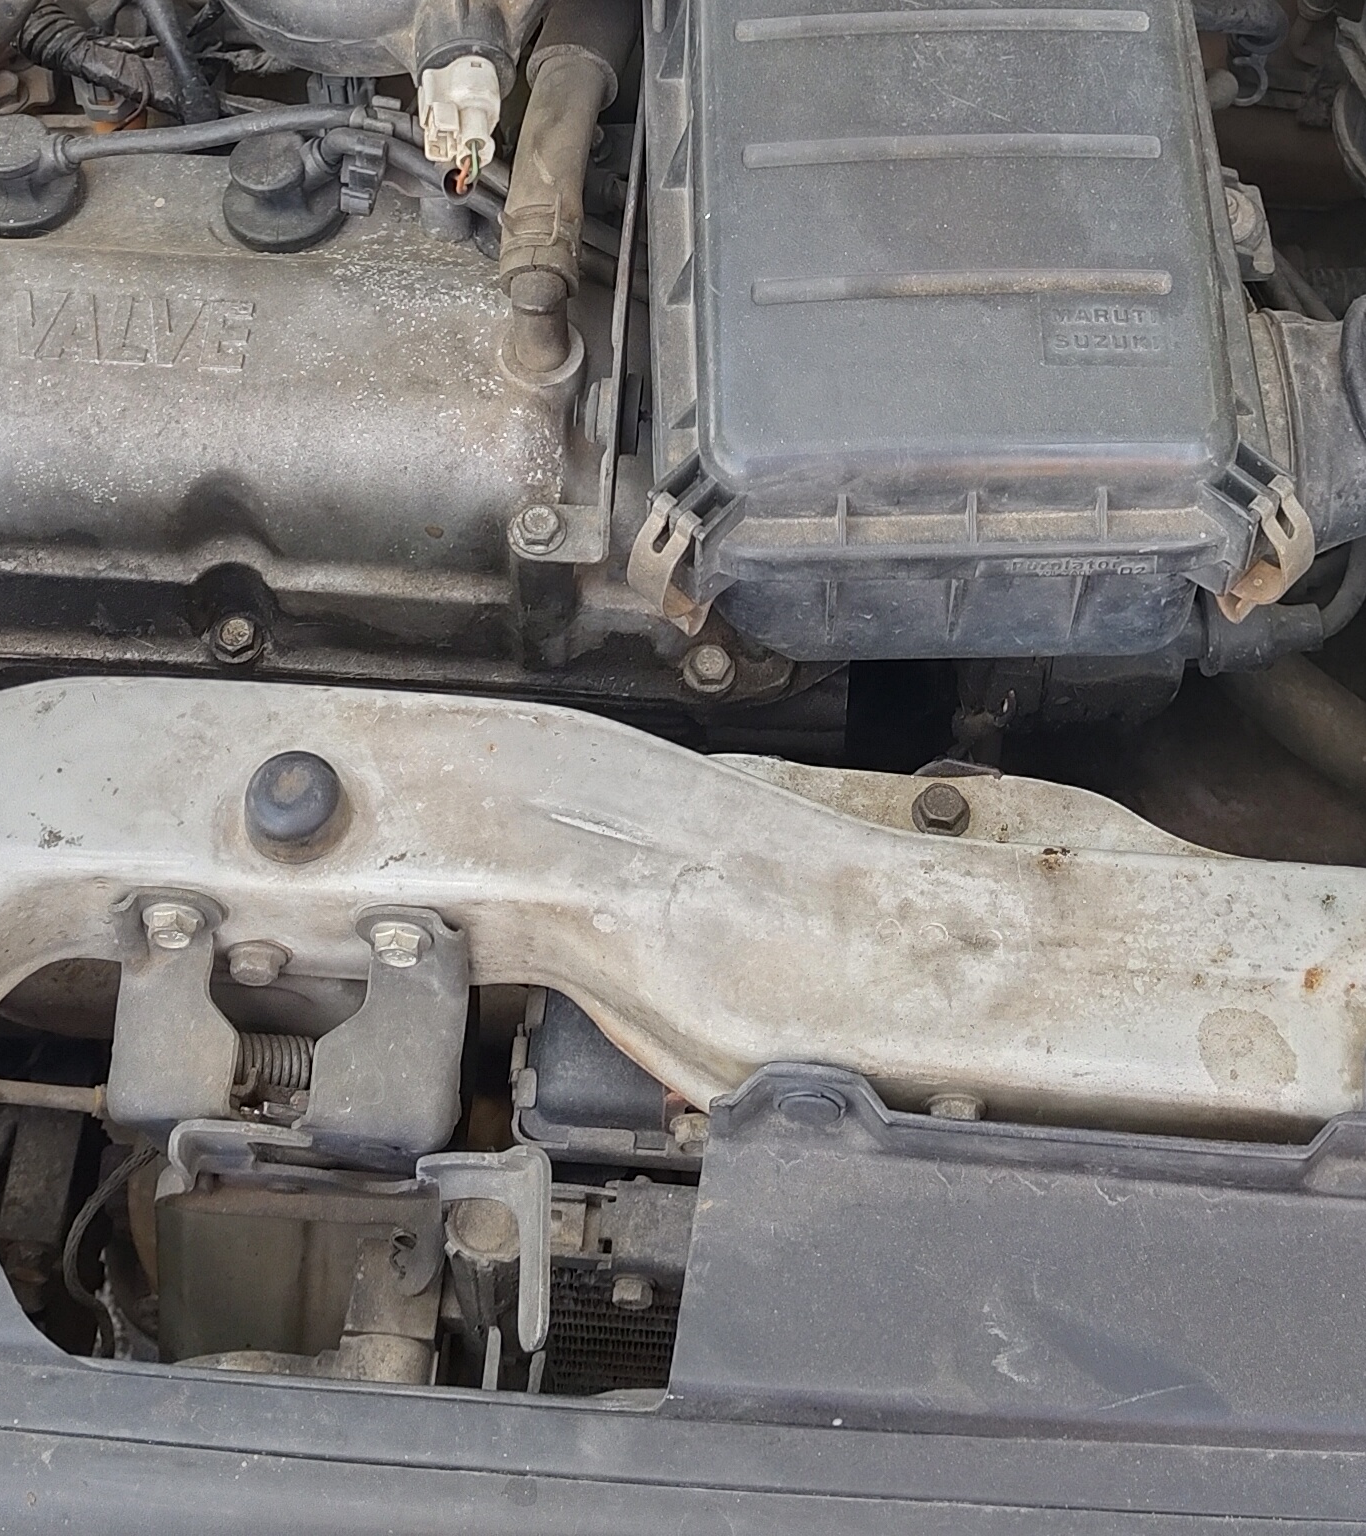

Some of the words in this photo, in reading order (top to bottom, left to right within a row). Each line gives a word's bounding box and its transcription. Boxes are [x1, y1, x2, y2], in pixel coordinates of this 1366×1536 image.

[1049, 308, 1158, 325] MARUTI
[15, 287, 257, 372] VALVE
[1053, 333, 1160, 351] SUZUKI
